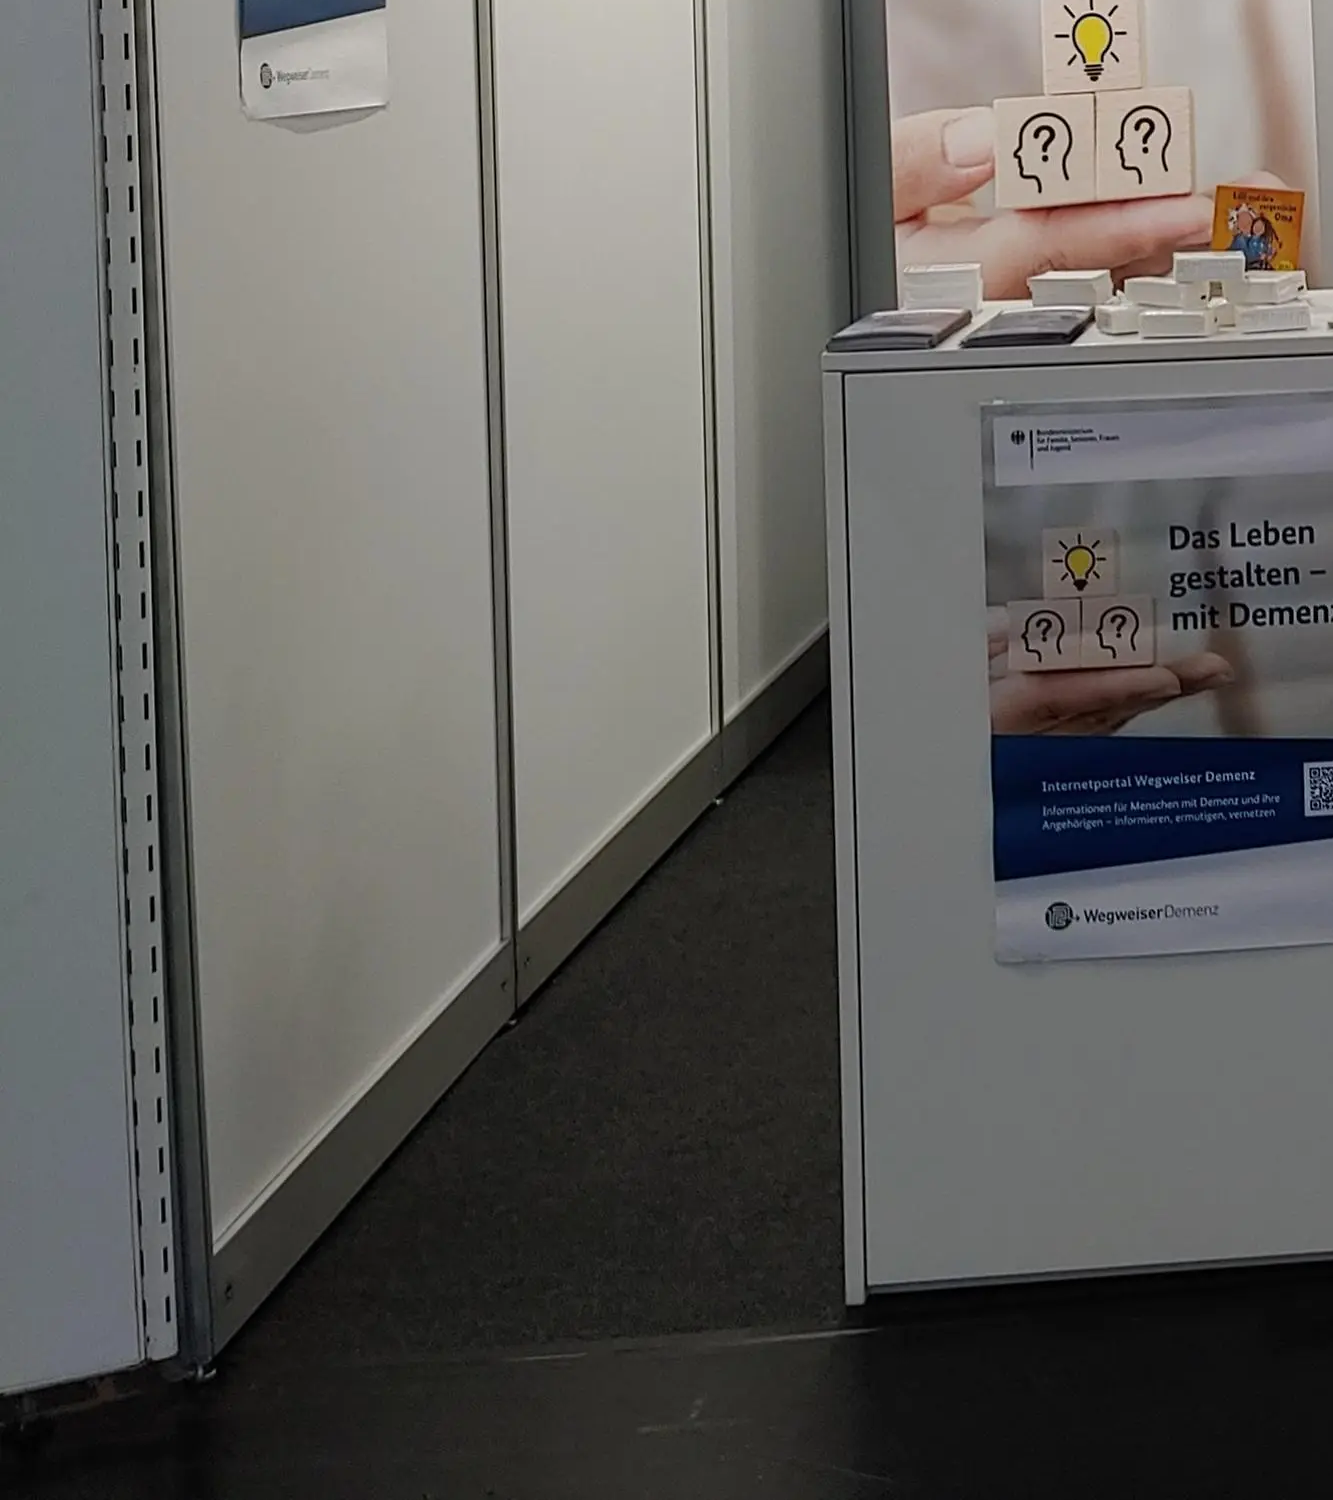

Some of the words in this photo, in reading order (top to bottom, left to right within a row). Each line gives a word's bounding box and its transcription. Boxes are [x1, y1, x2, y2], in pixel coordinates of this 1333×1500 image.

[1169, 525, 1220, 551] Das
[1230, 520, 1315, 549] Leben
[1169, 561, 1300, 597] gestalten
[1172, 603, 1220, 631] mit
[1042, 775, 1132, 793] Internetportal
[1134, 772, 1203, 790] Wegweiser
[1205, 769, 1256, 783] Demenz
[1042, 803, 1112, 817] Informationen
[1114, 800, 1127, 813] für
[1130, 797, 1180, 812] Menschen
[1181, 797, 1198, 810] mit
[1200, 795, 1239, 808] Demenz
[1241, 793, 1260, 805] und
[1262, 792, 1281, 804] ihre
[1042, 817, 1104, 833] Angehörigen
[1114, 812, 1173, 827] informieren,
[1175, 809, 1227, 825] ermutigen,
[1229, 807, 1277, 821] vernetzen
[1083, 903, 1220, 926] WegweiserDemenz
